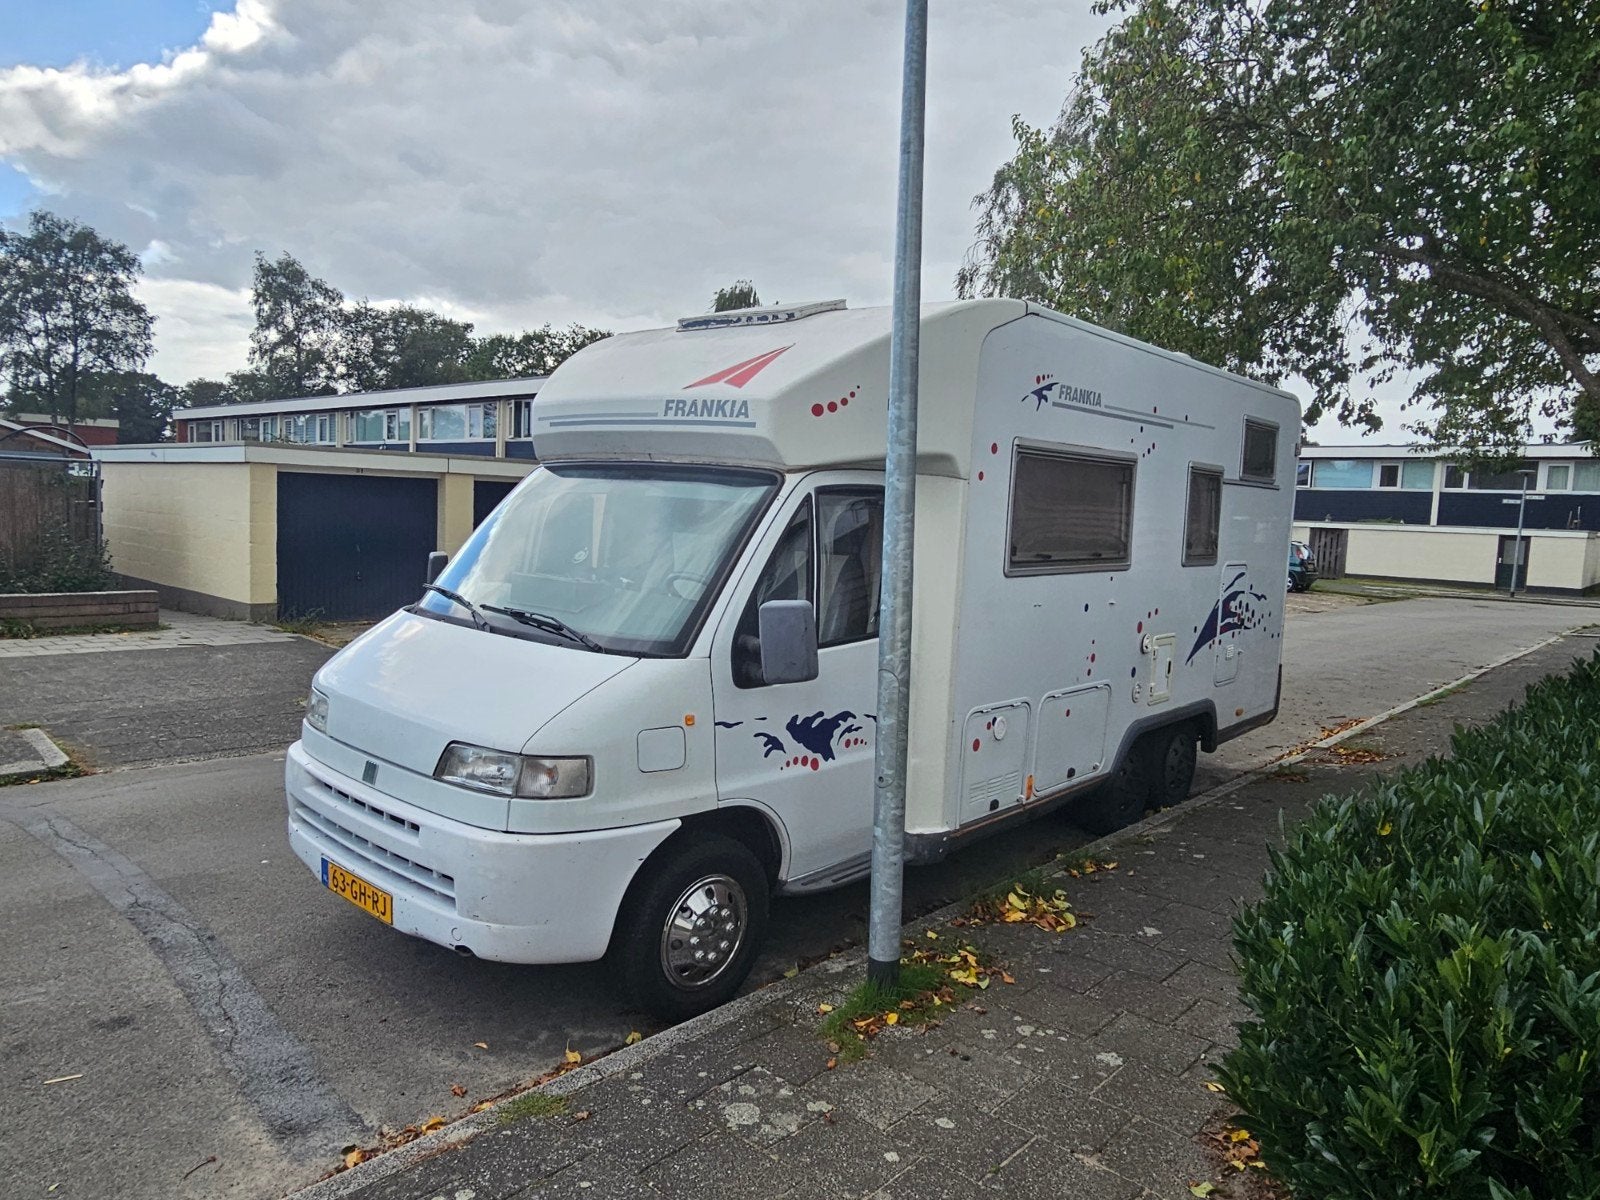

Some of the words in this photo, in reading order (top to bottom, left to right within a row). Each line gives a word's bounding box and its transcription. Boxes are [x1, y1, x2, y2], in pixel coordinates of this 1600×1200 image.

[1059, 384, 1102, 408] FRANKIA
[663, 399, 749, 418] FRANKIA
[332, 869, 387, 916] 63-GH-RJ
